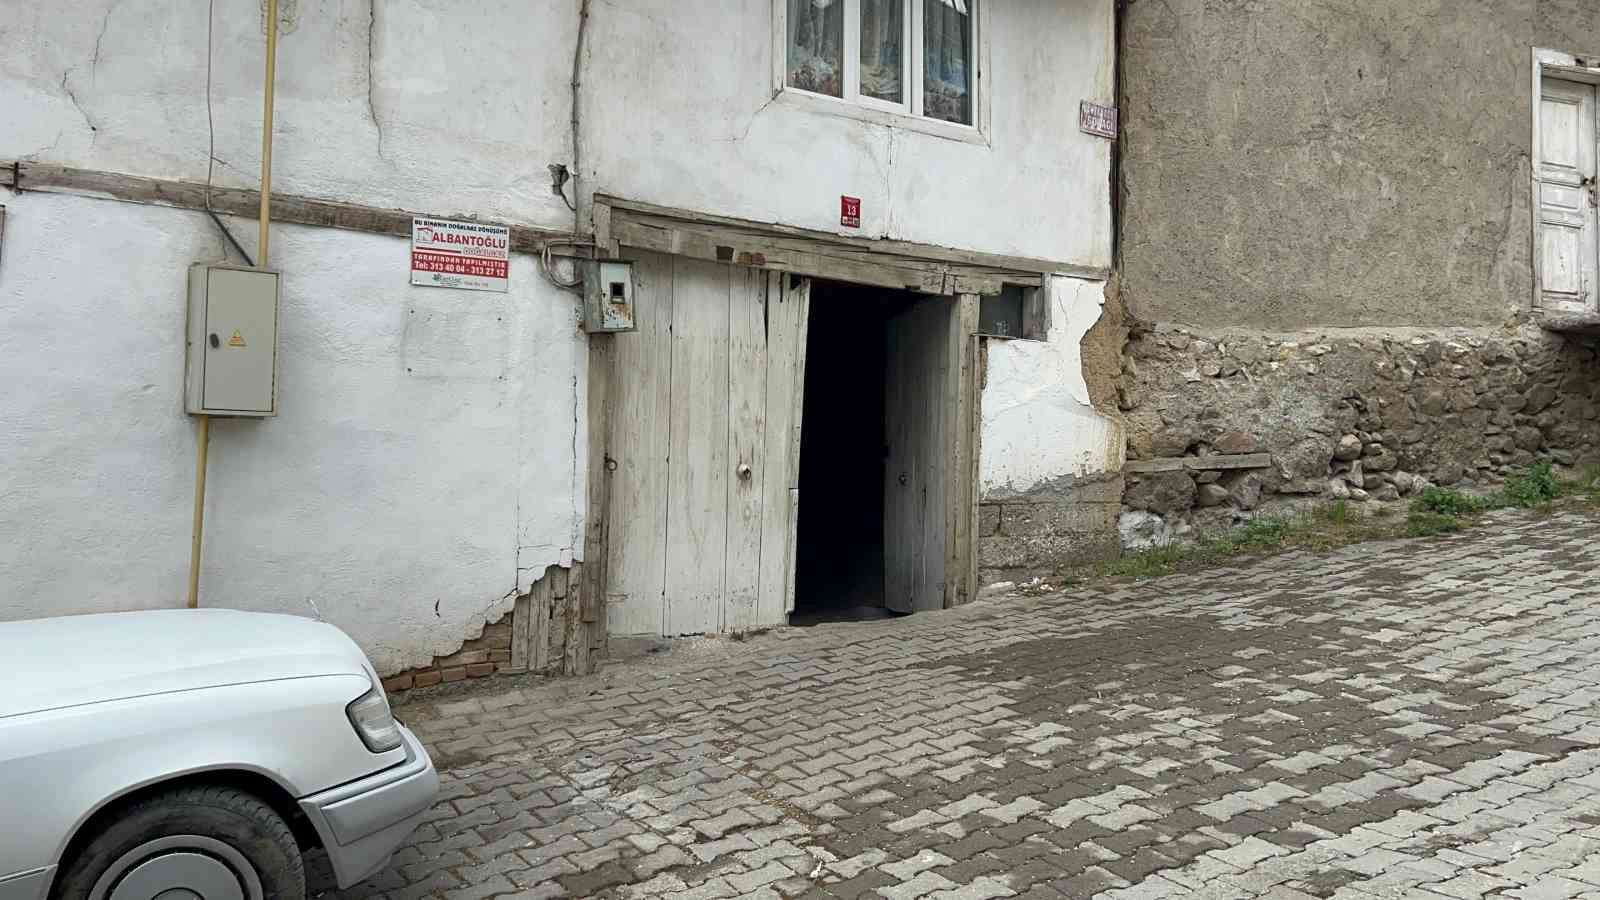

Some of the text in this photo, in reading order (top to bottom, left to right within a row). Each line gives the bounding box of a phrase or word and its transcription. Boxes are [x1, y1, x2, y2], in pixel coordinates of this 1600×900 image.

[432, 232, 506, 249] ALBANTOĞLU
[414, 253, 461, 264] TARAFINDAN
[414, 261, 429, 269] Tel:
[430, 262, 443, 271] 313
[445, 264, 454, 272] 40
[456, 265, 465, 273] 04
[486, 268, 494, 276] 27
[496, 268, 505, 276] 12
